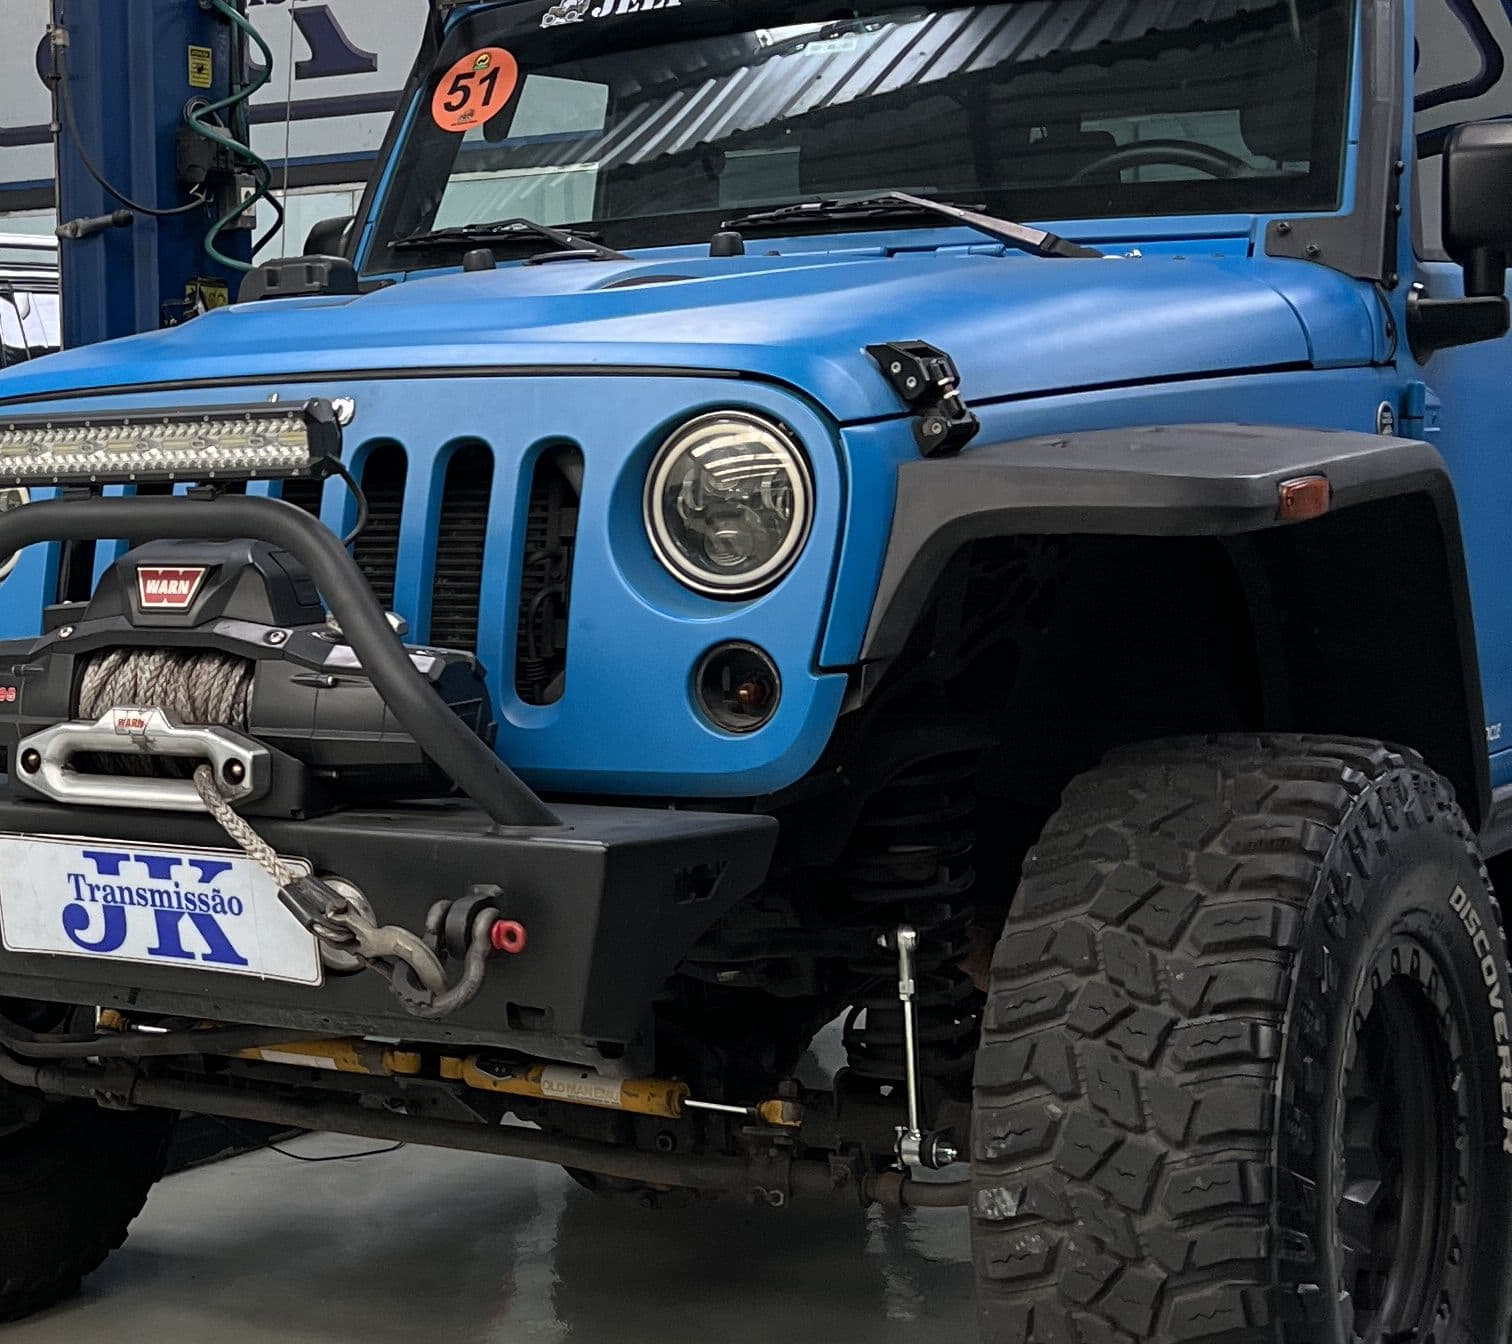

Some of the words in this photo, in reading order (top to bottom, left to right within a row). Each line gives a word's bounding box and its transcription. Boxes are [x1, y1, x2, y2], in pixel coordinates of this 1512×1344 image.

[443, 66, 501, 113] 51
[146, 579, 190, 595] WARN
[118, 718, 145, 729] WARN
[62, 849, 249, 967] JK
[67, 872, 244, 917] Transmissão
[1448, 884, 1512, 1154] DISCOVERER
